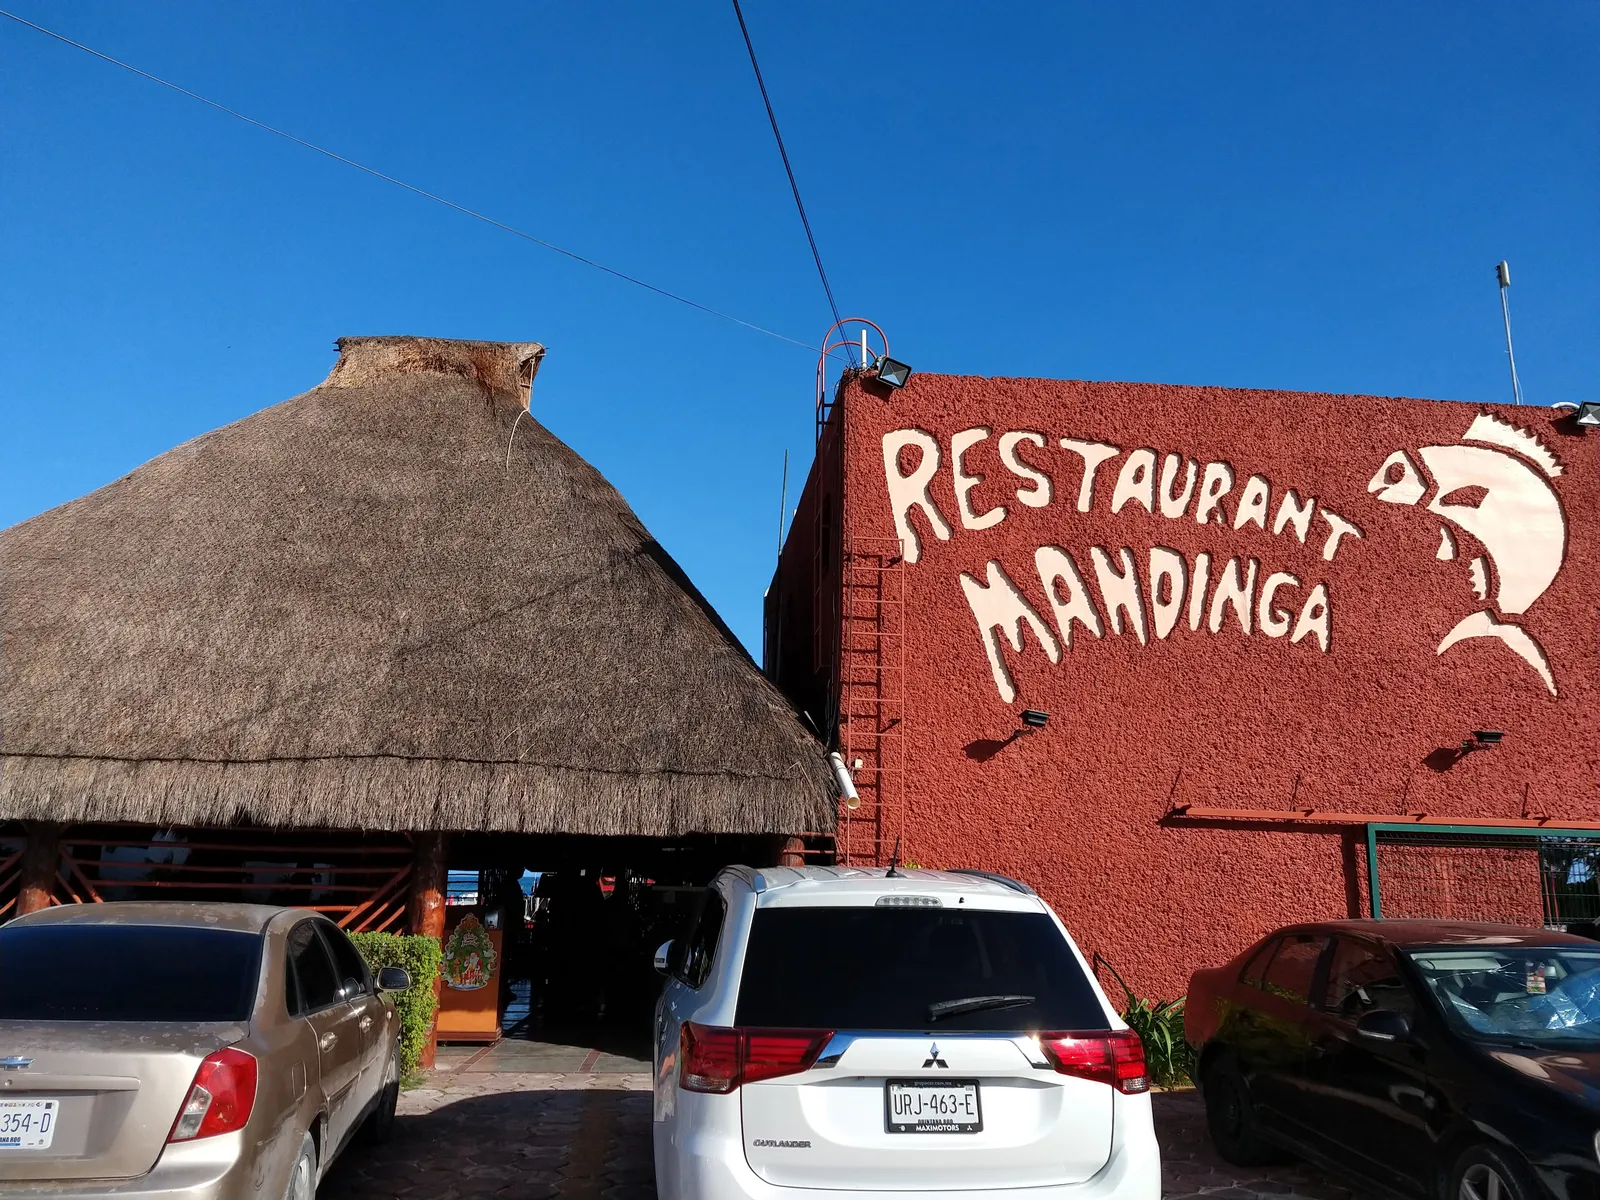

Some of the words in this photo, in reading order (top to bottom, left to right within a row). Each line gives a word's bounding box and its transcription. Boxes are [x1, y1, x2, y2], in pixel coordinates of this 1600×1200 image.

[882, 428, 1362, 564] RESTAURANT
[959, 546, 1331, 704] MANDINGA
[894, 1094, 975, 1115] URJ-463-E
[915, 1124, 960, 1132] MAXIMOTORS
[753, 1139, 811, 1148] OUTLANDER
